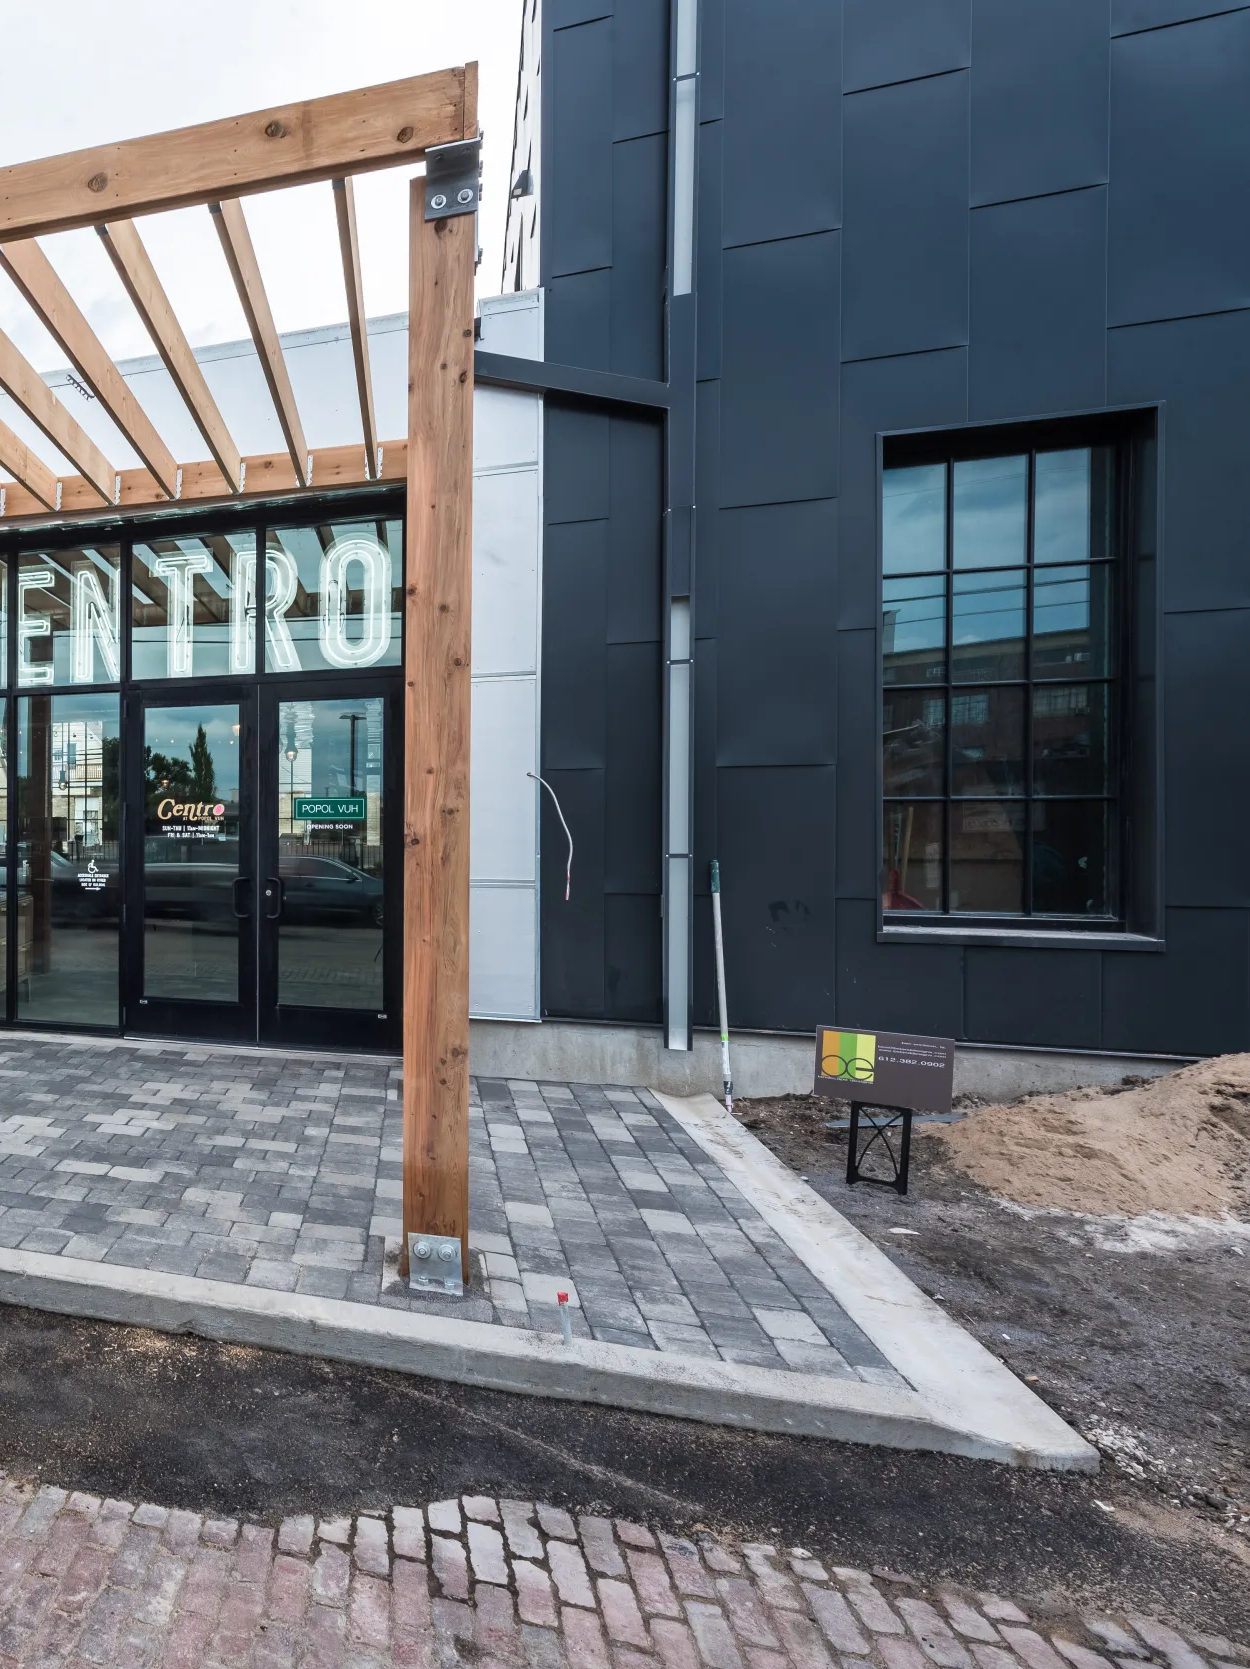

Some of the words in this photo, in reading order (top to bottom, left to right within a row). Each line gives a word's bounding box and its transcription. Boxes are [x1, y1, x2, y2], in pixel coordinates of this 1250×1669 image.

[157, 798, 225, 821] Centro
[302, 804, 334, 813] POPOL
[337, 804, 359, 813] VUH
[878, 1055, 946, 1069] 612.382.0902
